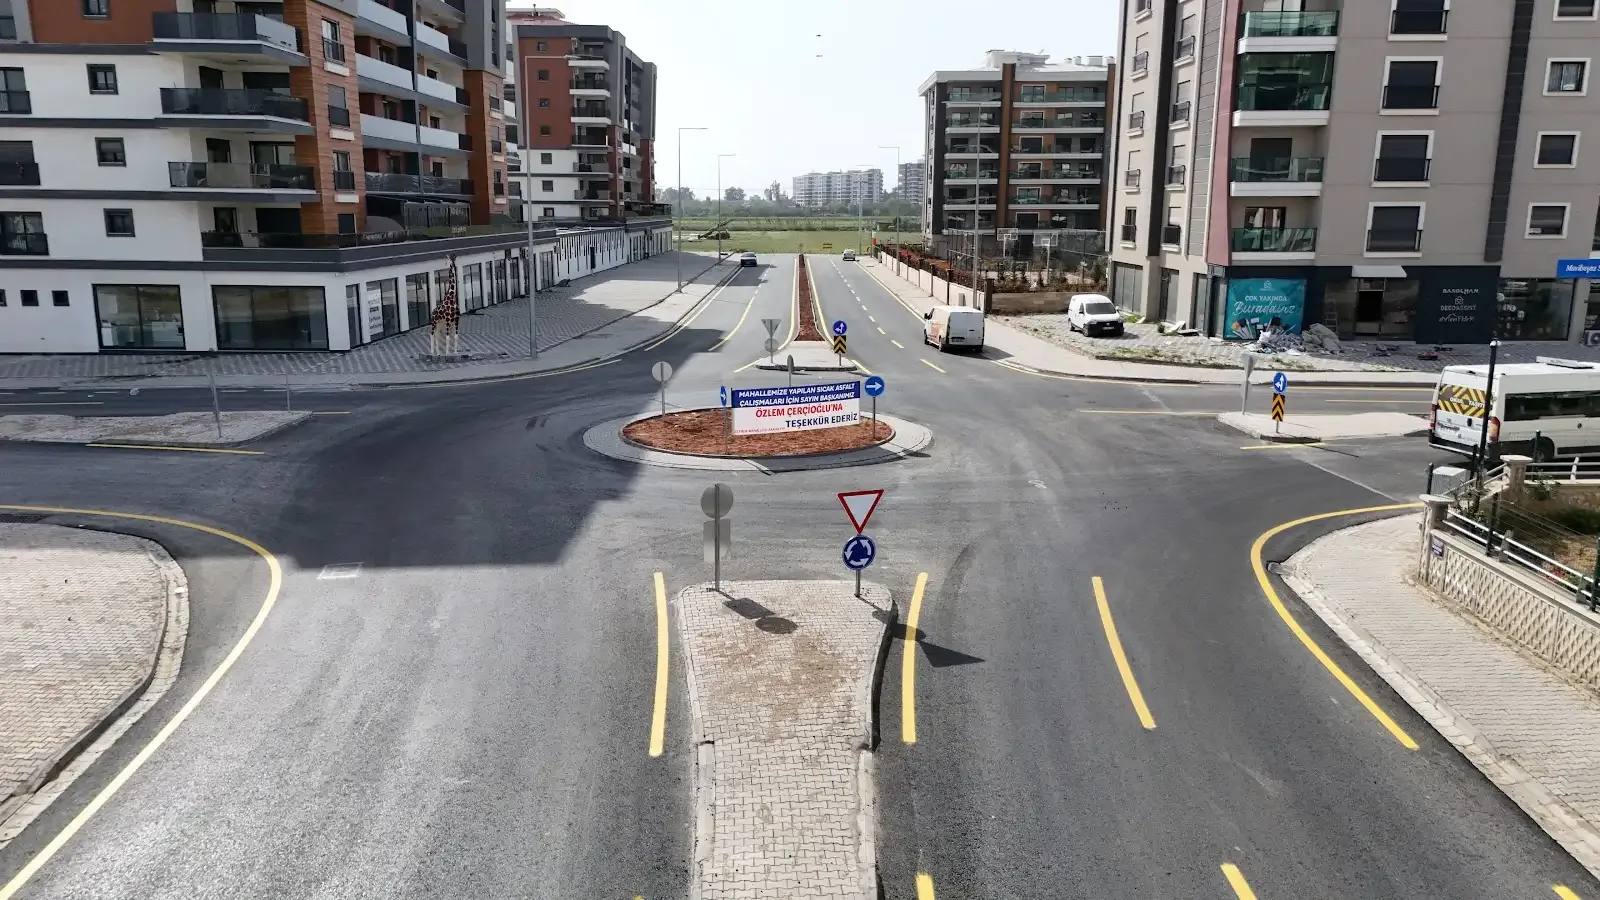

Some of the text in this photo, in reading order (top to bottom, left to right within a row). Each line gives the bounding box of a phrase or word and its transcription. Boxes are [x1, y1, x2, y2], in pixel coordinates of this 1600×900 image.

[739, 383, 855, 398] MAHALLEMİZE YAPILAN SICAK ASFALT
[739, 391, 855, 407] ÇALIŞMALARI İÇİN SAYIN BAŞKANIMIZ
[755, 403, 843, 418] ÖZLEM ÇERÇİOĞLU'NA
[785, 413, 858, 428] TEŞEKKÜR EDERİZ
